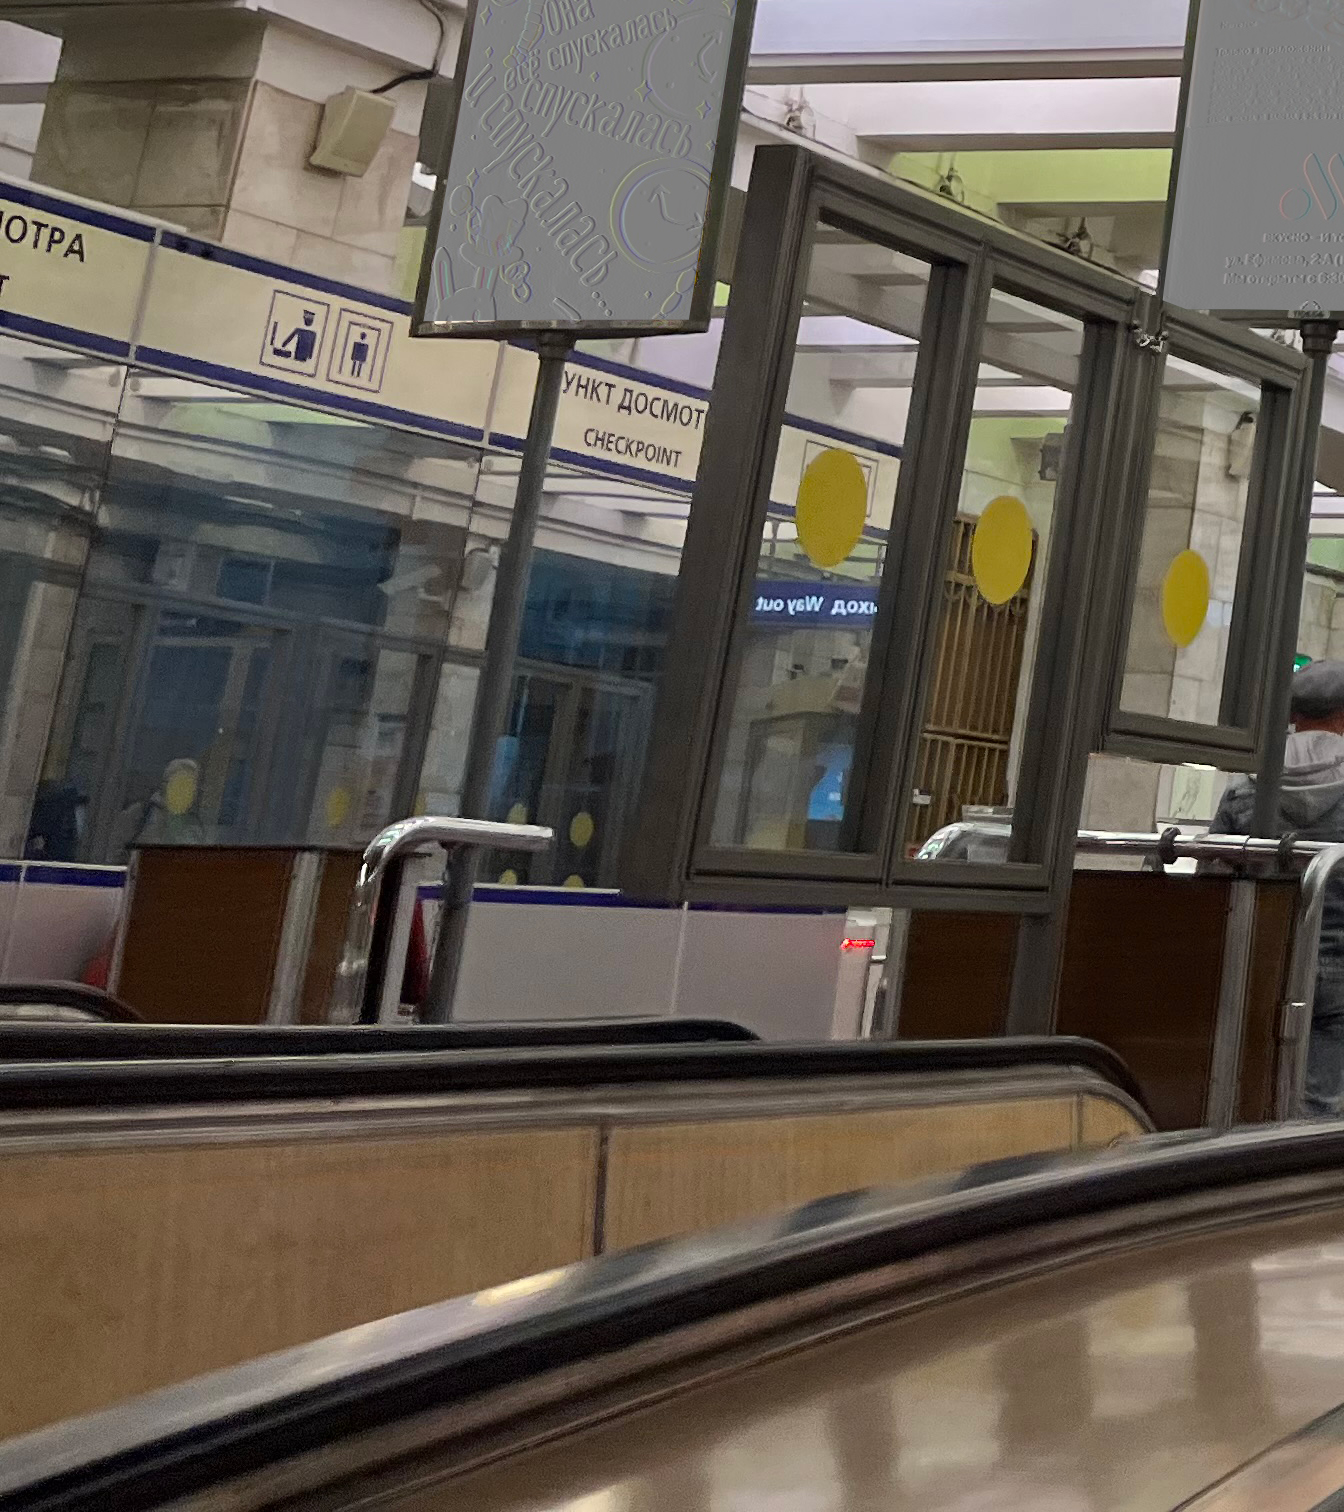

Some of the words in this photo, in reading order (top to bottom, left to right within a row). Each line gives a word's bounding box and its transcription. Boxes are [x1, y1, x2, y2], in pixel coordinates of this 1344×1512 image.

[503, 49, 541, 91] всё
[547, 7, 678, 74] спускалась
[520, 78, 694, 159] спускалась
[562, 370, 616, 406] УНКТ
[617, 387, 706, 430] ДОСМОТ
[583, 428, 682, 469] CHECKPOINT
